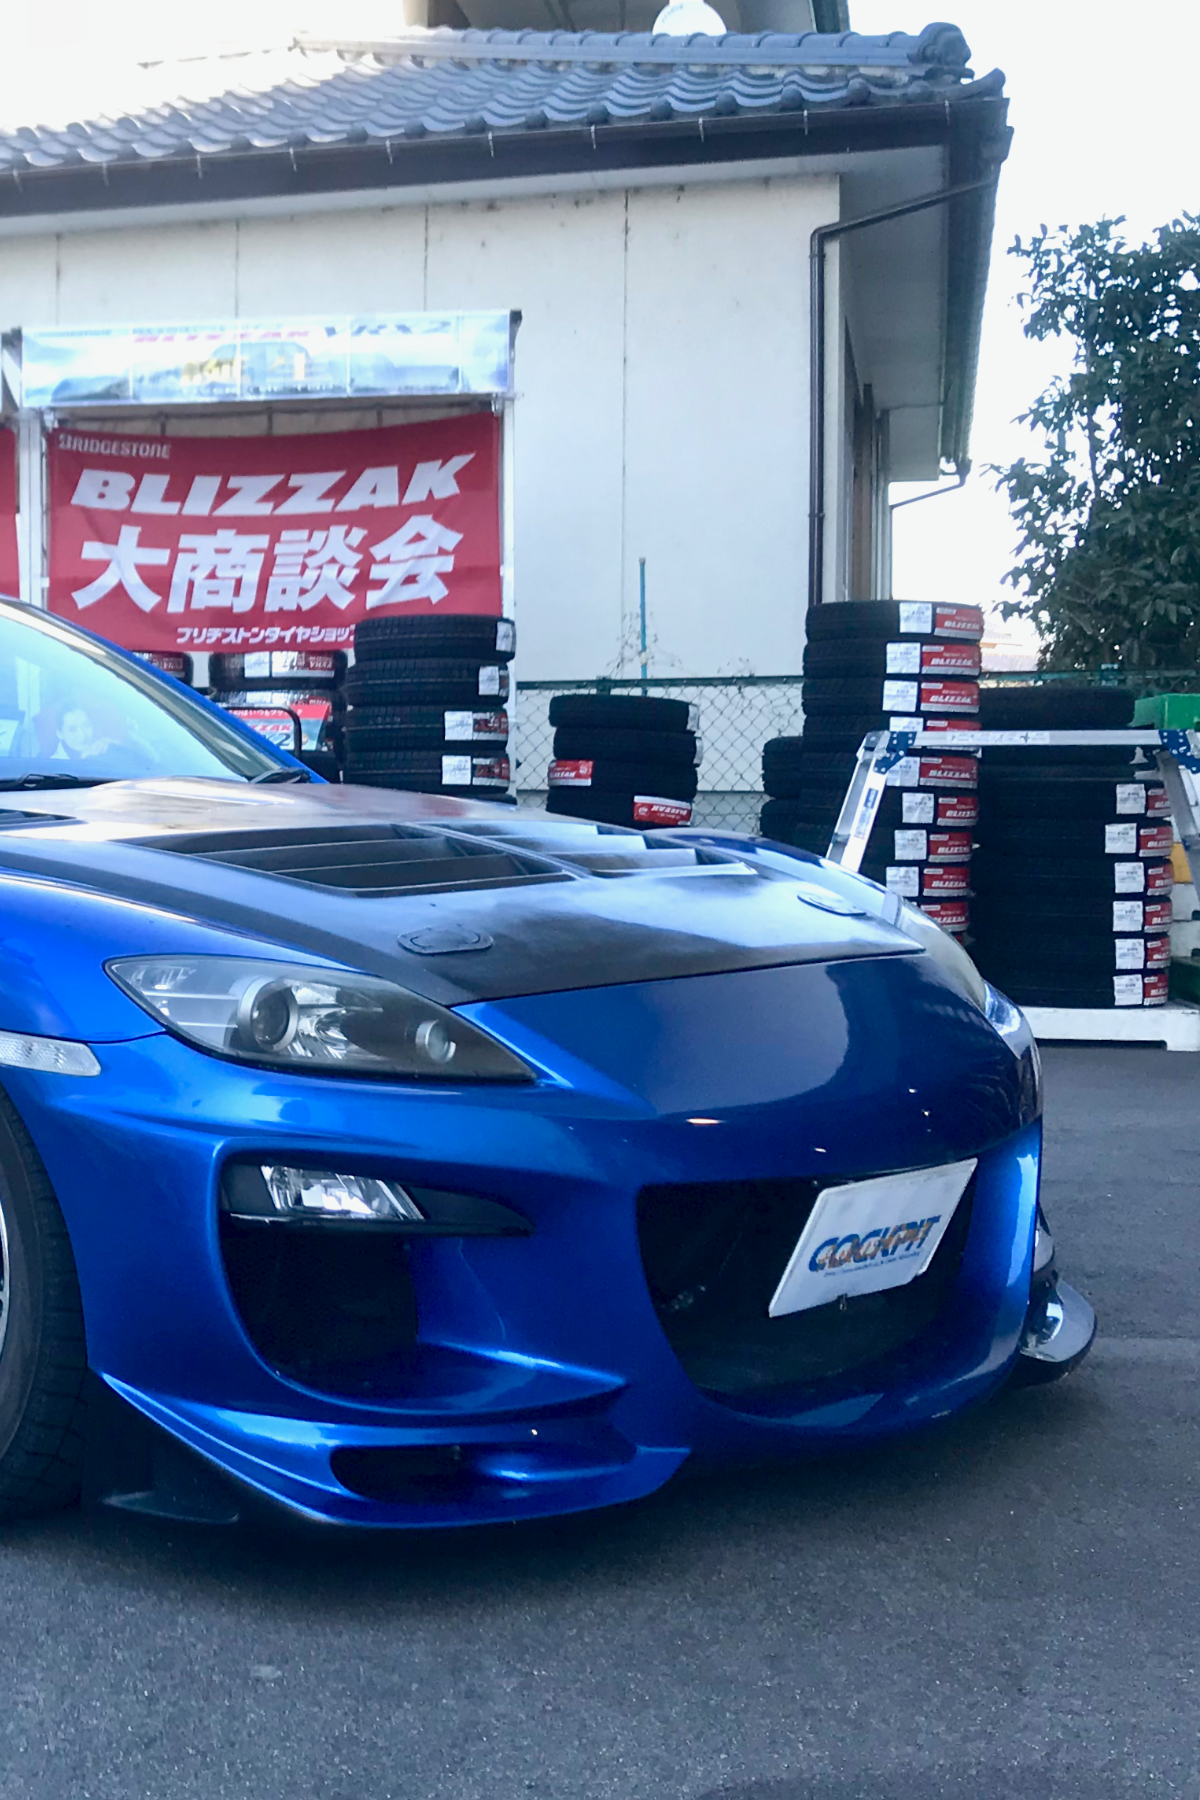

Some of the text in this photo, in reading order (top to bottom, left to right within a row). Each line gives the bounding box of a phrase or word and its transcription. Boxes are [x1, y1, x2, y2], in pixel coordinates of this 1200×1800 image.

[58, 433, 171, 459] BRIDGESTONE
[70, 453, 476, 516] BLIZZAK
[71, 513, 464, 614] 大商談会
[808, 1214, 942, 1273] COCKPIT
